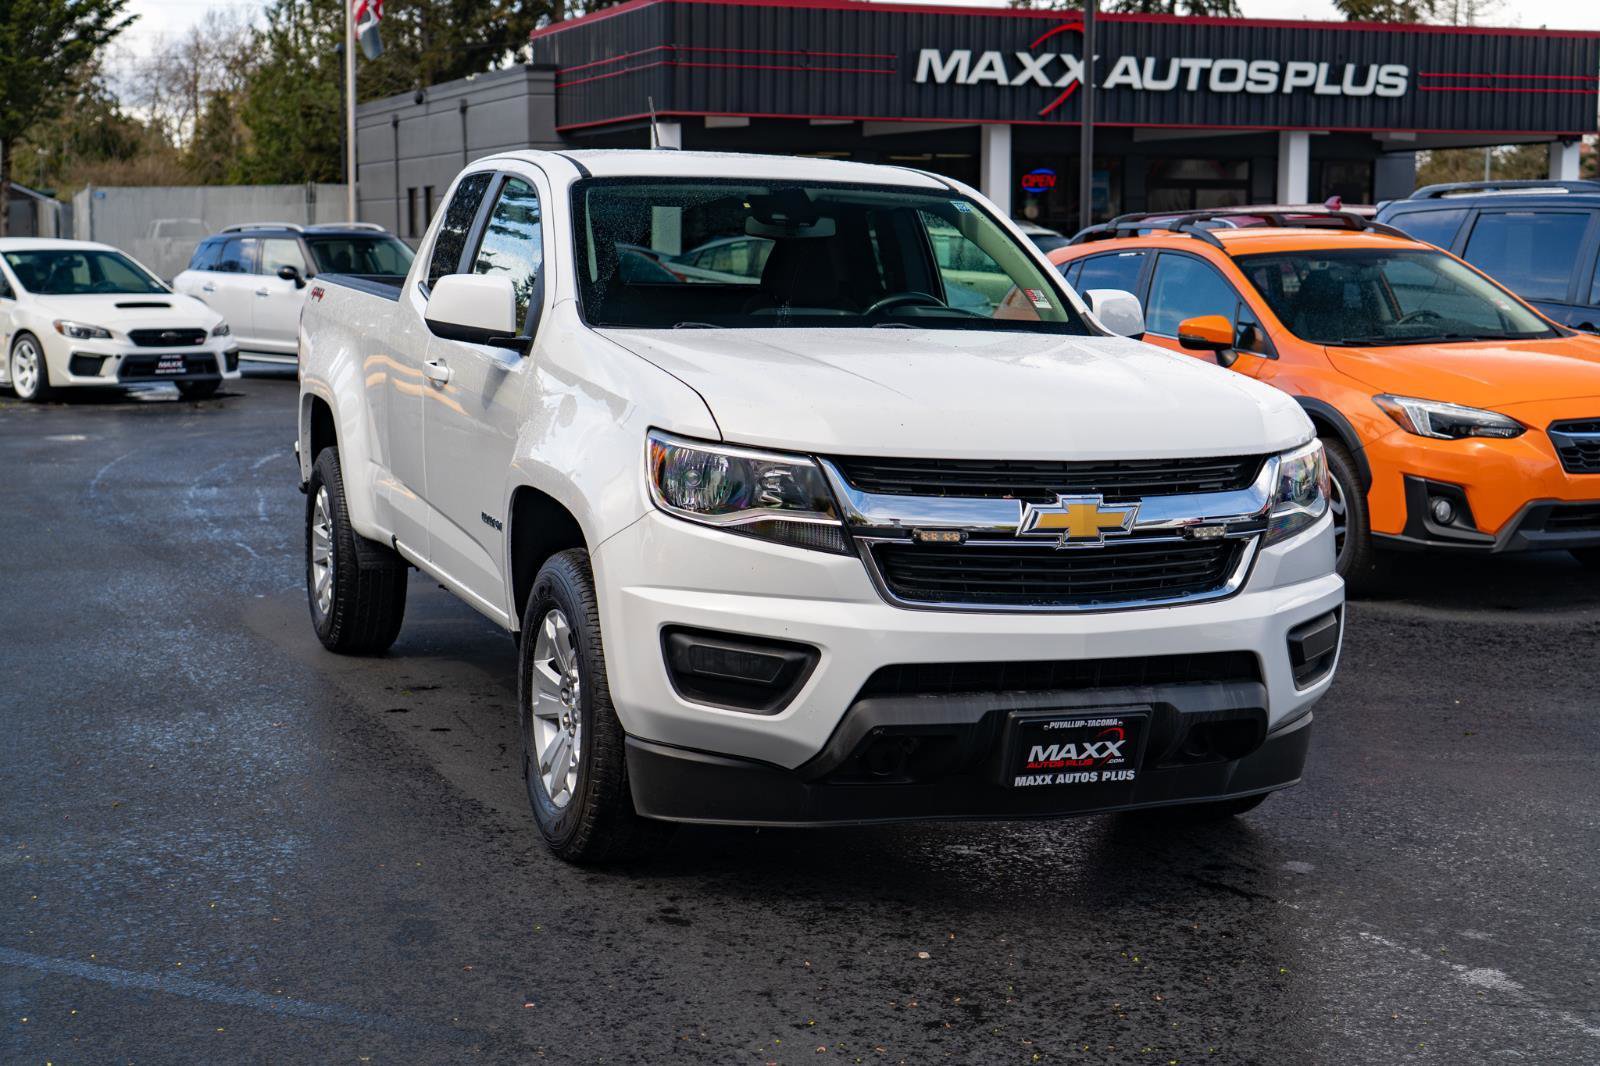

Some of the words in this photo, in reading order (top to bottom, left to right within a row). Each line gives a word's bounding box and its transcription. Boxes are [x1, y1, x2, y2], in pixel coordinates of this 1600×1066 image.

[915, 48, 1099, 88] MAXX
[1103, 56, 1279, 94] AUTOS
[1282, 62, 1409, 97] PLUS
[1021, 174, 1057, 188] OPEN
[1028, 740, 1126, 762] MAXX
[1027, 760, 1065, 768] AUTOS
[1065, 758, 1094, 766] PLUS
[1014, 774, 1052, 787] MAXX
[1055, 772, 1098, 784] AUTOS
[1102, 770, 1136, 781] PLUS
